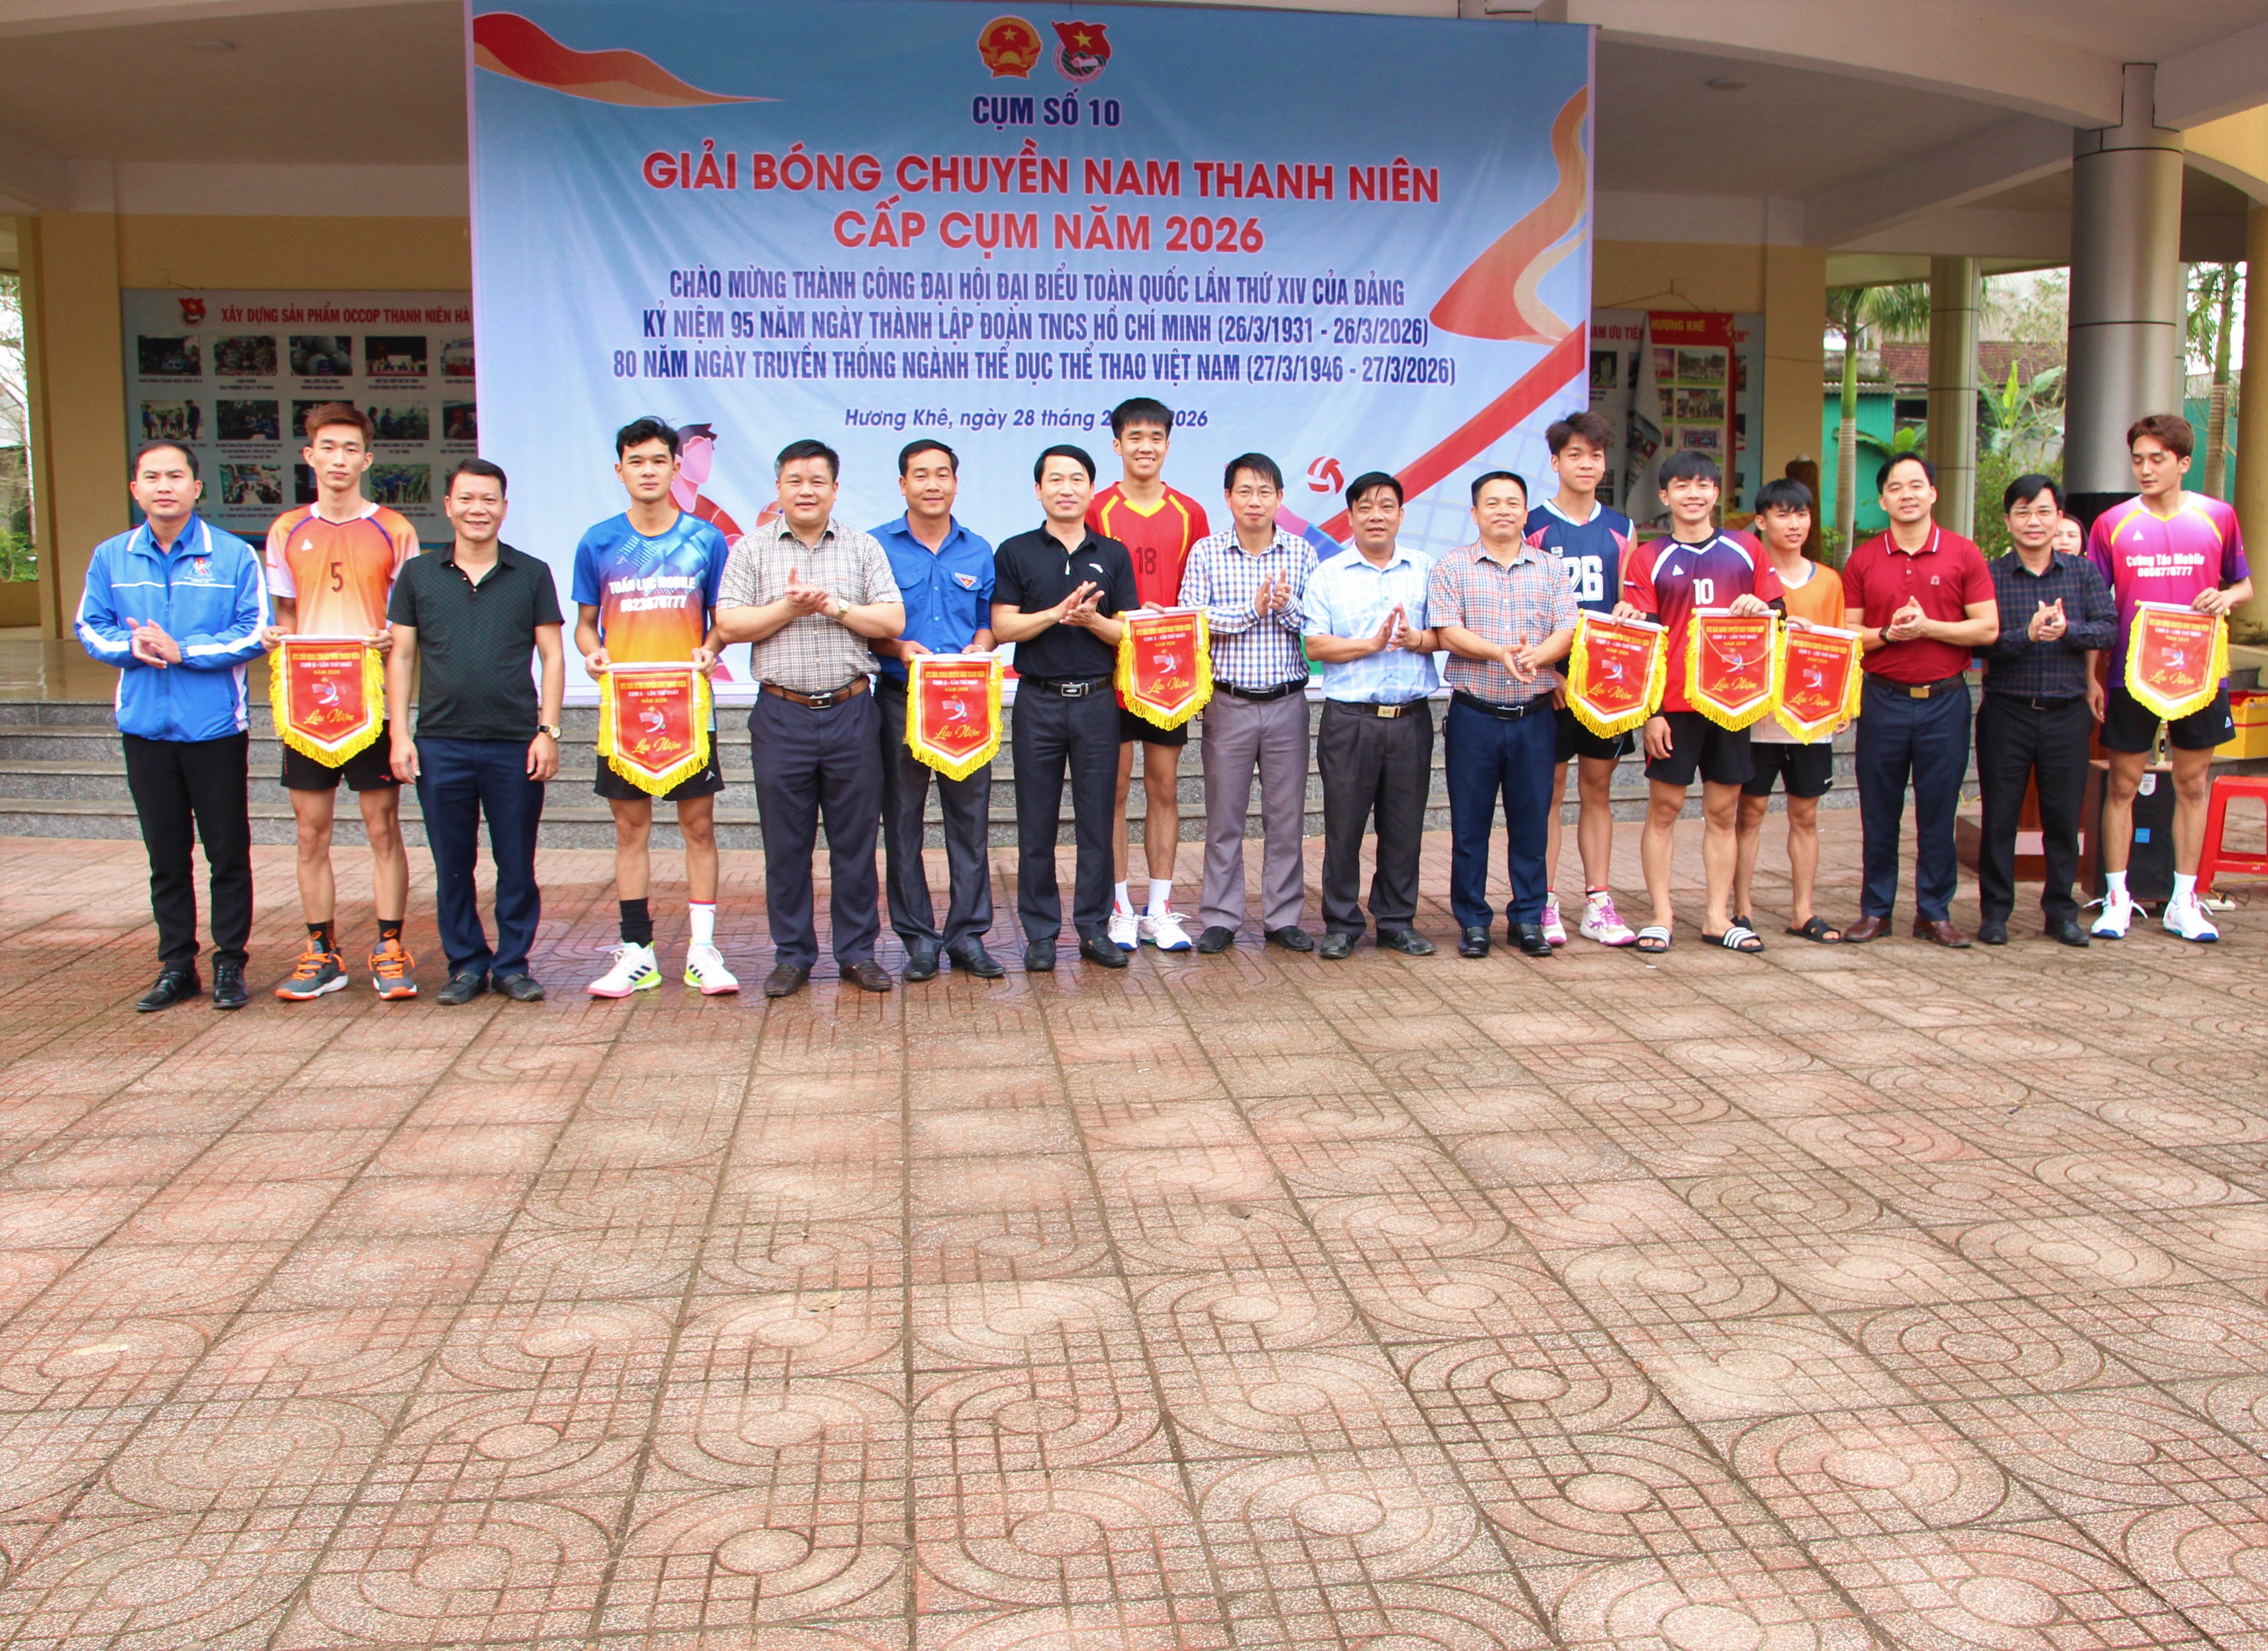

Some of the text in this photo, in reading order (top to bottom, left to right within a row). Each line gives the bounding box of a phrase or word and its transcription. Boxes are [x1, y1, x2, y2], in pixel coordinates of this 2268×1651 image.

[973, 88, 1120, 130] CỤM SỐ 10
[643, 137, 1439, 203] GIẢI BÓNG CHUYỀN NAM THANH NIÊN
[833, 194, 1264, 260] CẤP CỤM NĂM 2026
[670, 262, 1404, 307] CHÀO MỪNG THÀNH CÔNG ĐẠI HỘI ĐẠI BIỂU TOÀN QUỐC LẦN THỨ XIV CỦA ĐẢNG
[222, 302, 470, 326] XÂY DỰNG SẢN PHẨM OCCOP THANH NIÊN HÀ
[644, 300, 667, 338] KỶ
[674, 305, 724, 344] NIỆM
[731, 311, 753, 338] 95
[760, 305, 805, 339] NĂM
[812, 305, 864, 340] NGÀY
[869, 306, 932, 340] THÀNH
[939, 307, 973, 345] LẬP
[980, 307, 1032, 340] ĐOÀN
[1039, 312, 1088, 341] TNCS
[1094, 304, 1119, 341] HỒ
[1125, 309, 1155, 341] CHÍ
[1162, 314, 1211, 343] MINH
[1218, 315, 1313, 345] (26/3/1931
[1333, 317, 1428, 348] 26/3/2026)
[614, 350, 636, 378] 80
[644, 344, 688, 378] NĂM
[695, 345, 746, 378] NGÀY
[753, 342, 827, 379] TRUYỀN
[833, 342, 895, 379] THỐNG
[903, 346, 968, 379] NGÀNH
[975, 341, 1009, 380] THỂ
[1016, 352, 1053, 386] DỤC
[1059, 342, 1093, 380] THỂ
[1099, 353, 1146, 380] THAO
[1154, 348, 1191, 387] VIỆT
[1197, 354, 1240, 382] NAM
[1247, 355, 1343, 385] (27/3/1946
[1362, 356, 1456, 387] 27/3/2026)
[845, 408, 907, 431] Hương
[913, 408, 953, 430] Khê,
[960, 409, 1007, 431] ngày
[1013, 409, 1035, 427] 28
[1041, 408, 1095, 431] tháng
[330, 562, 344, 592] 5
[1135, 546, 1157, 574] 18
[1561, 555, 1603, 602] 26
[657, 576, 696, 589] MOBILE
[1692, 578, 1715, 605] 10
